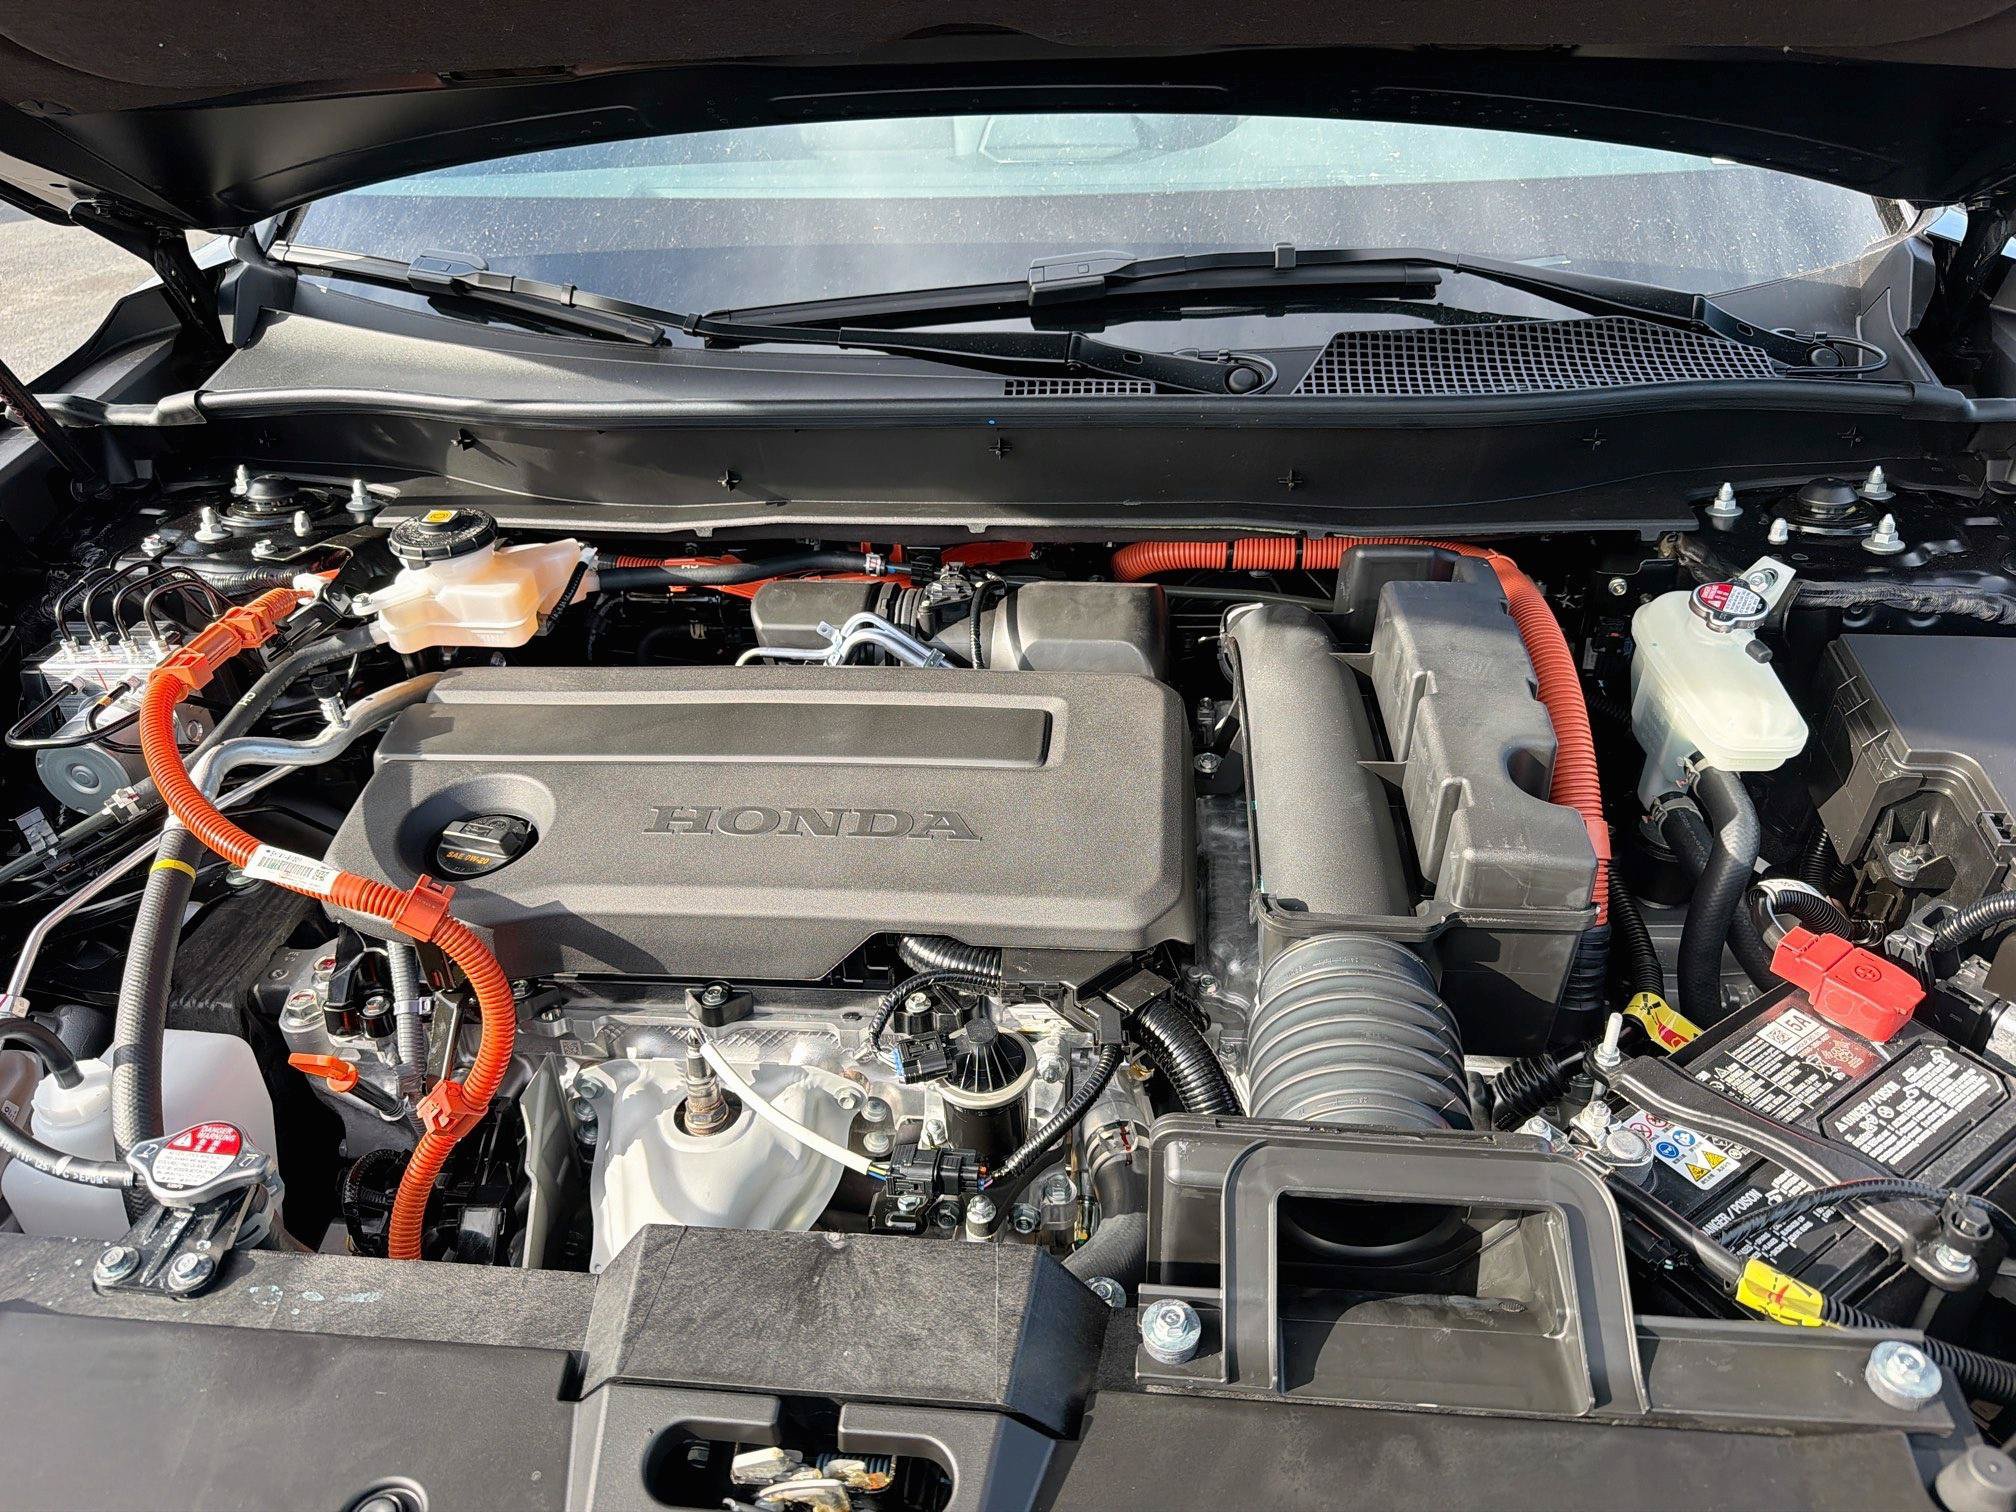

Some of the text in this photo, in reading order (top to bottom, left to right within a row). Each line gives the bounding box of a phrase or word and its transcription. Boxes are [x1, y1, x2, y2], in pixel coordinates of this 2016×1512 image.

[641, 805, 982, 842] HONDA
[446, 851, 491, 865] SAE 0W-20
[1785, 1014, 1812, 1032] 5A
